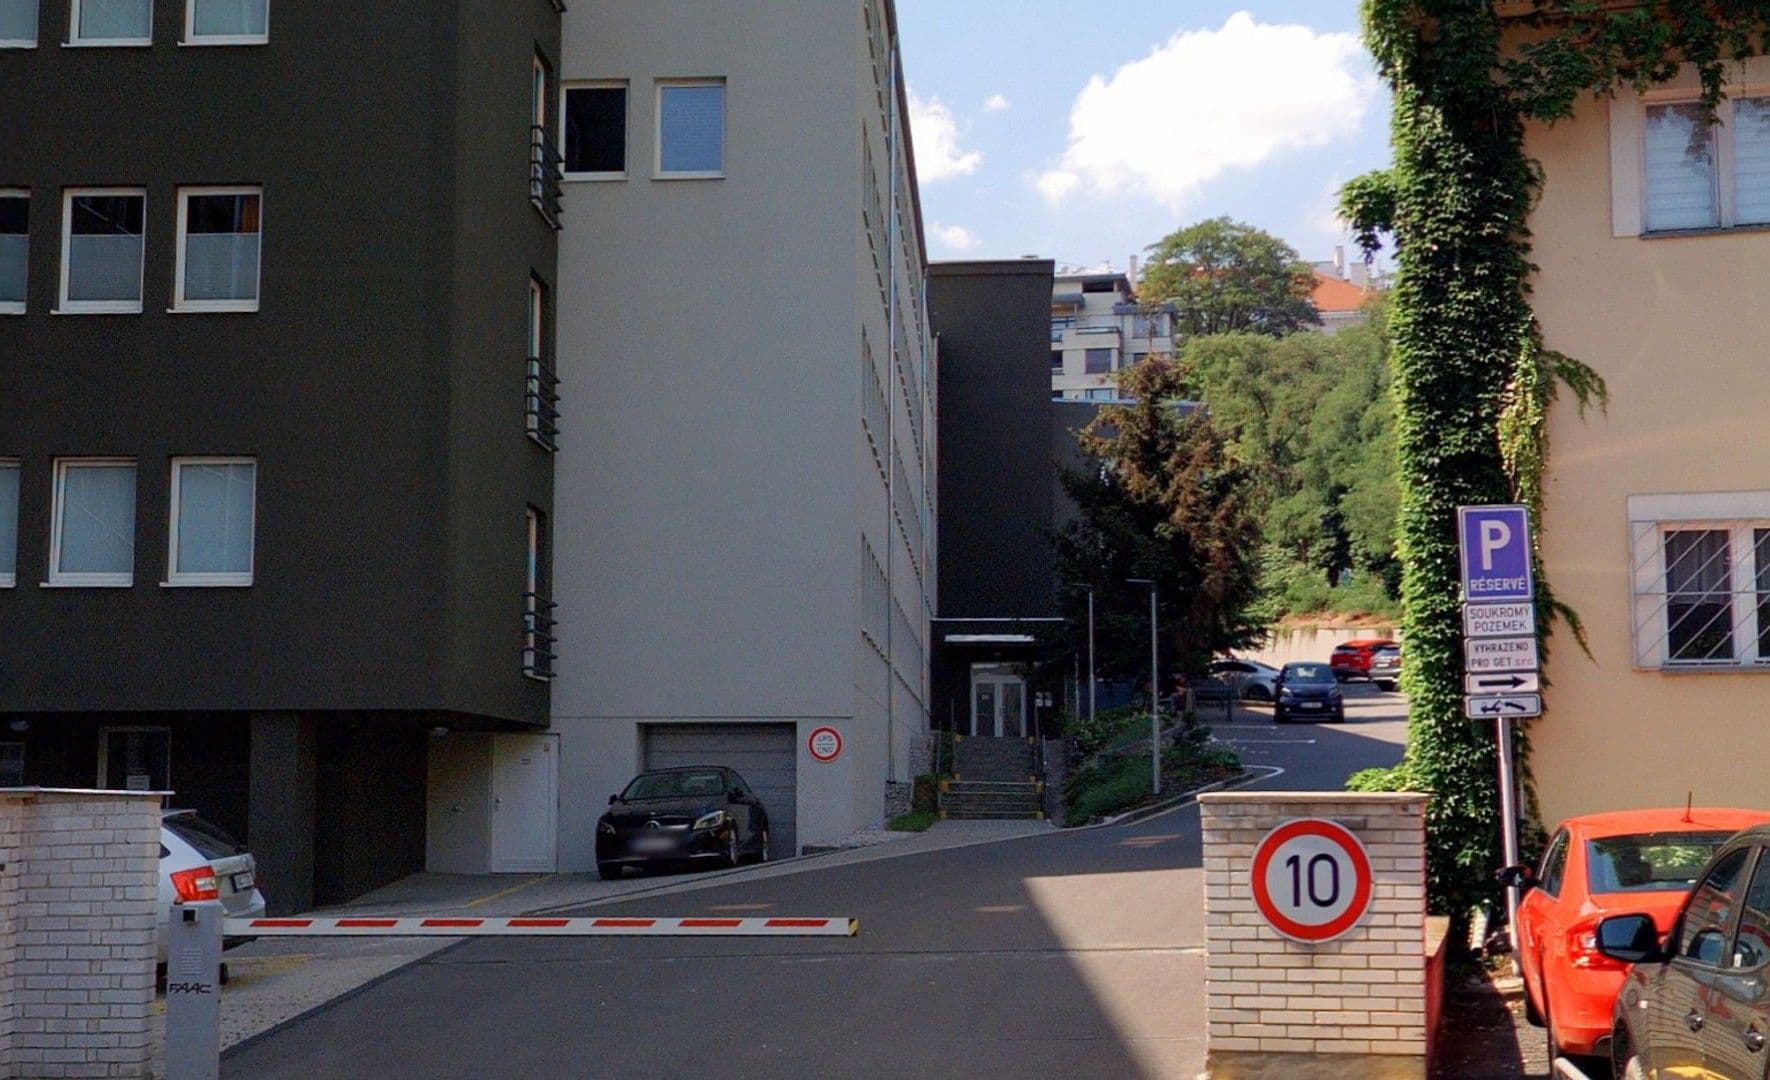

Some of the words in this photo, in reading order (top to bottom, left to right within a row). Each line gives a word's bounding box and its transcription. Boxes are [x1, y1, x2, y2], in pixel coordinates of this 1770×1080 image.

[1480, 519, 1511, 571] P
[1474, 620, 1527, 632] POZEMEK
[1474, 641, 1529, 653] VYHRAZENO
[1471, 657, 1490, 667] PRO
[1286, 853, 1339, 908] 10
[170, 982, 211, 994] FAAC
